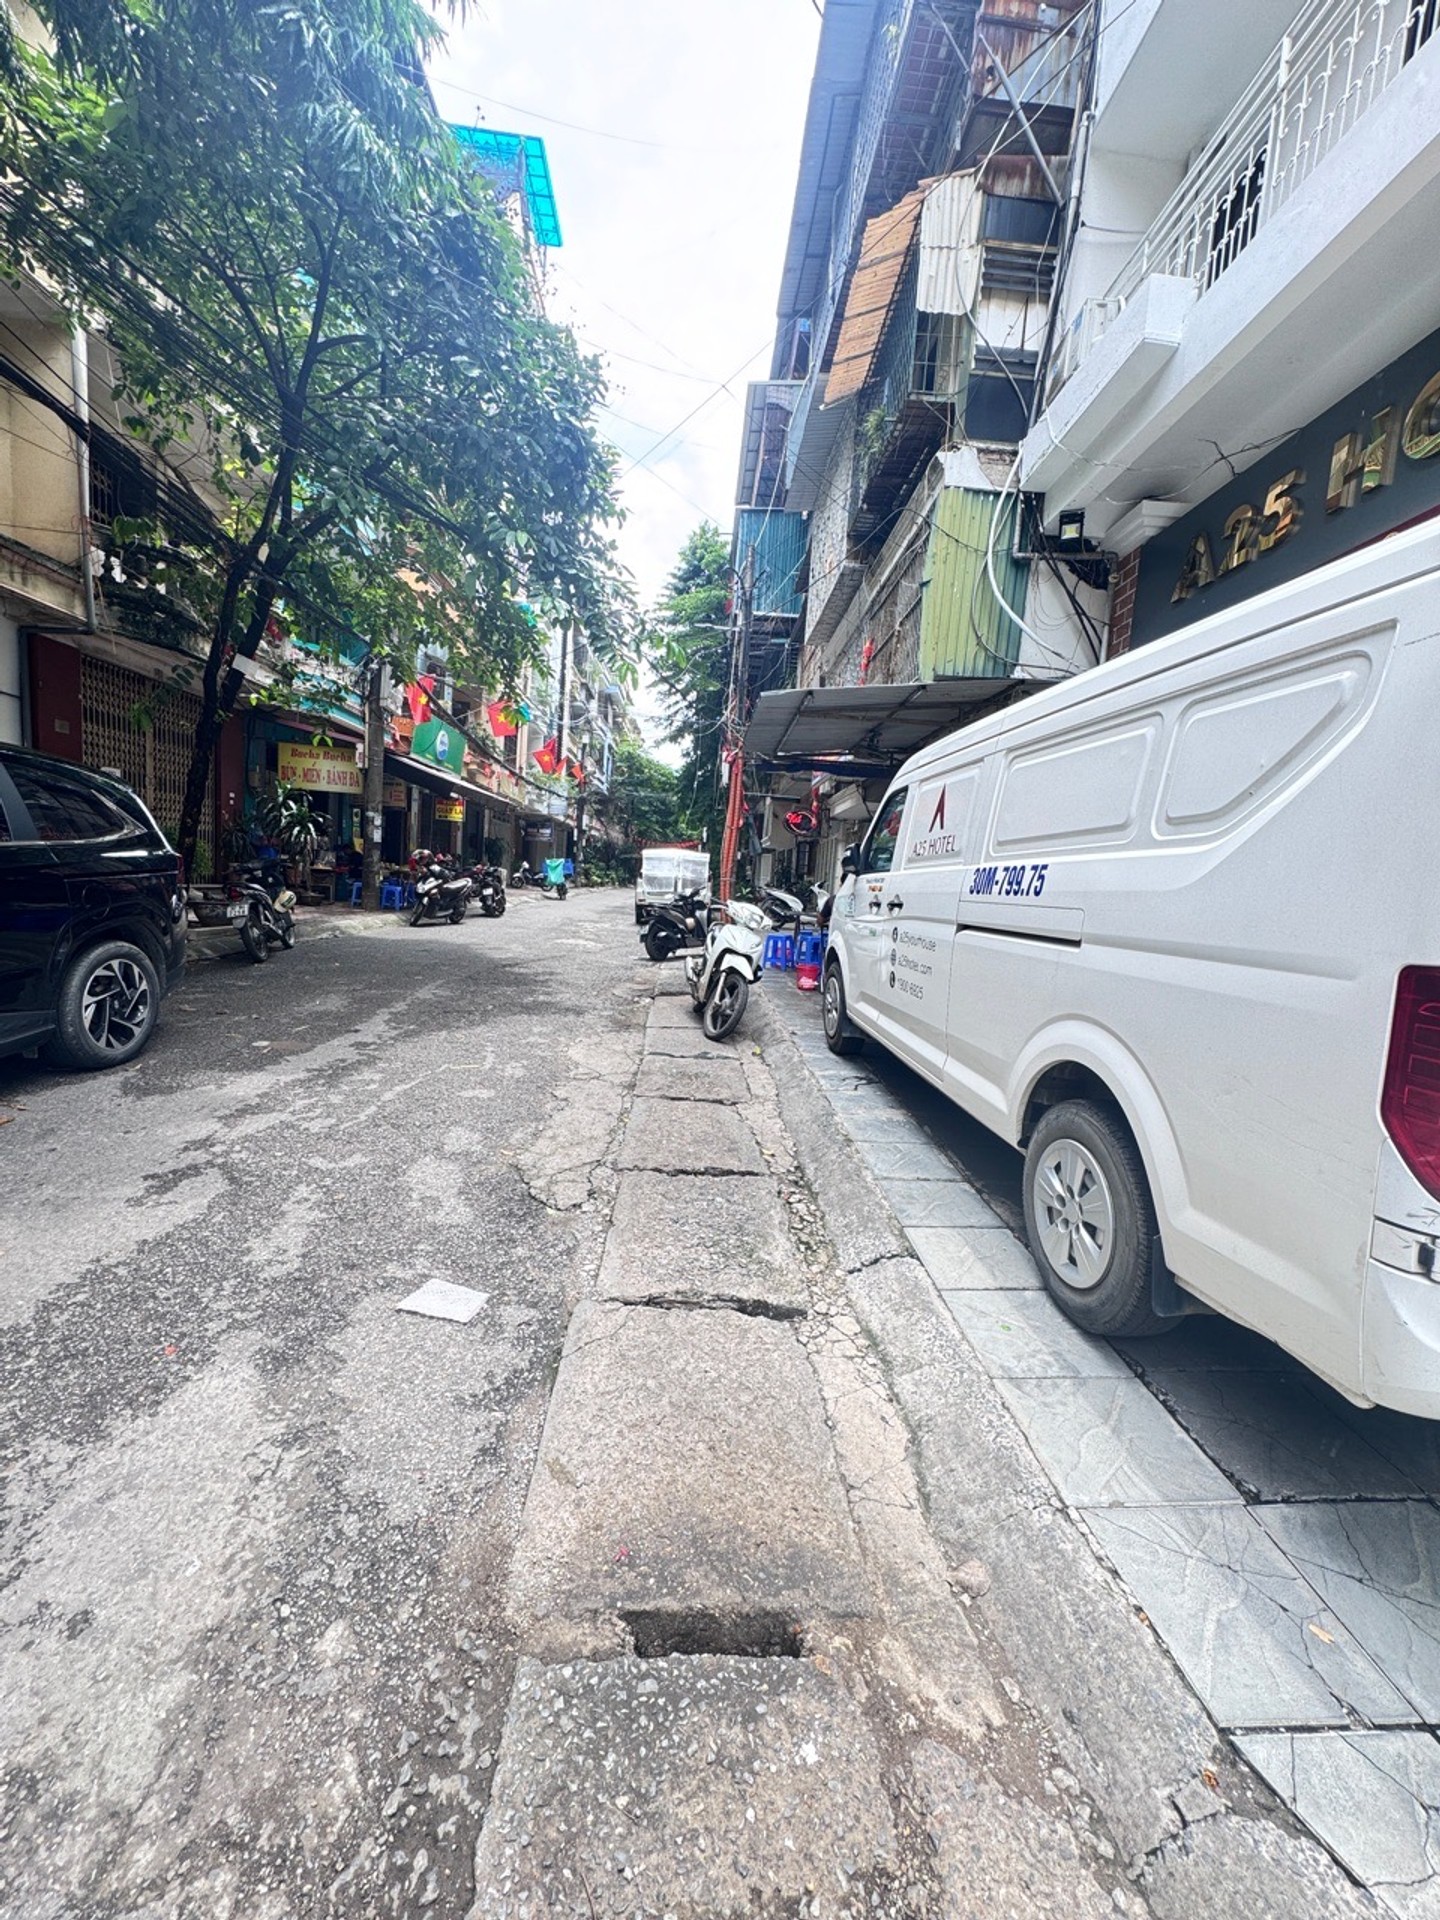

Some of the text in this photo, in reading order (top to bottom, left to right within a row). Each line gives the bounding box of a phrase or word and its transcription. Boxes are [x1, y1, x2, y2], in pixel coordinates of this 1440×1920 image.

[1170, 469, 1306, 604] A25
[912, 834, 956, 857] A25 HOTEL
[969, 864, 1049, 897] 30M-799.75
